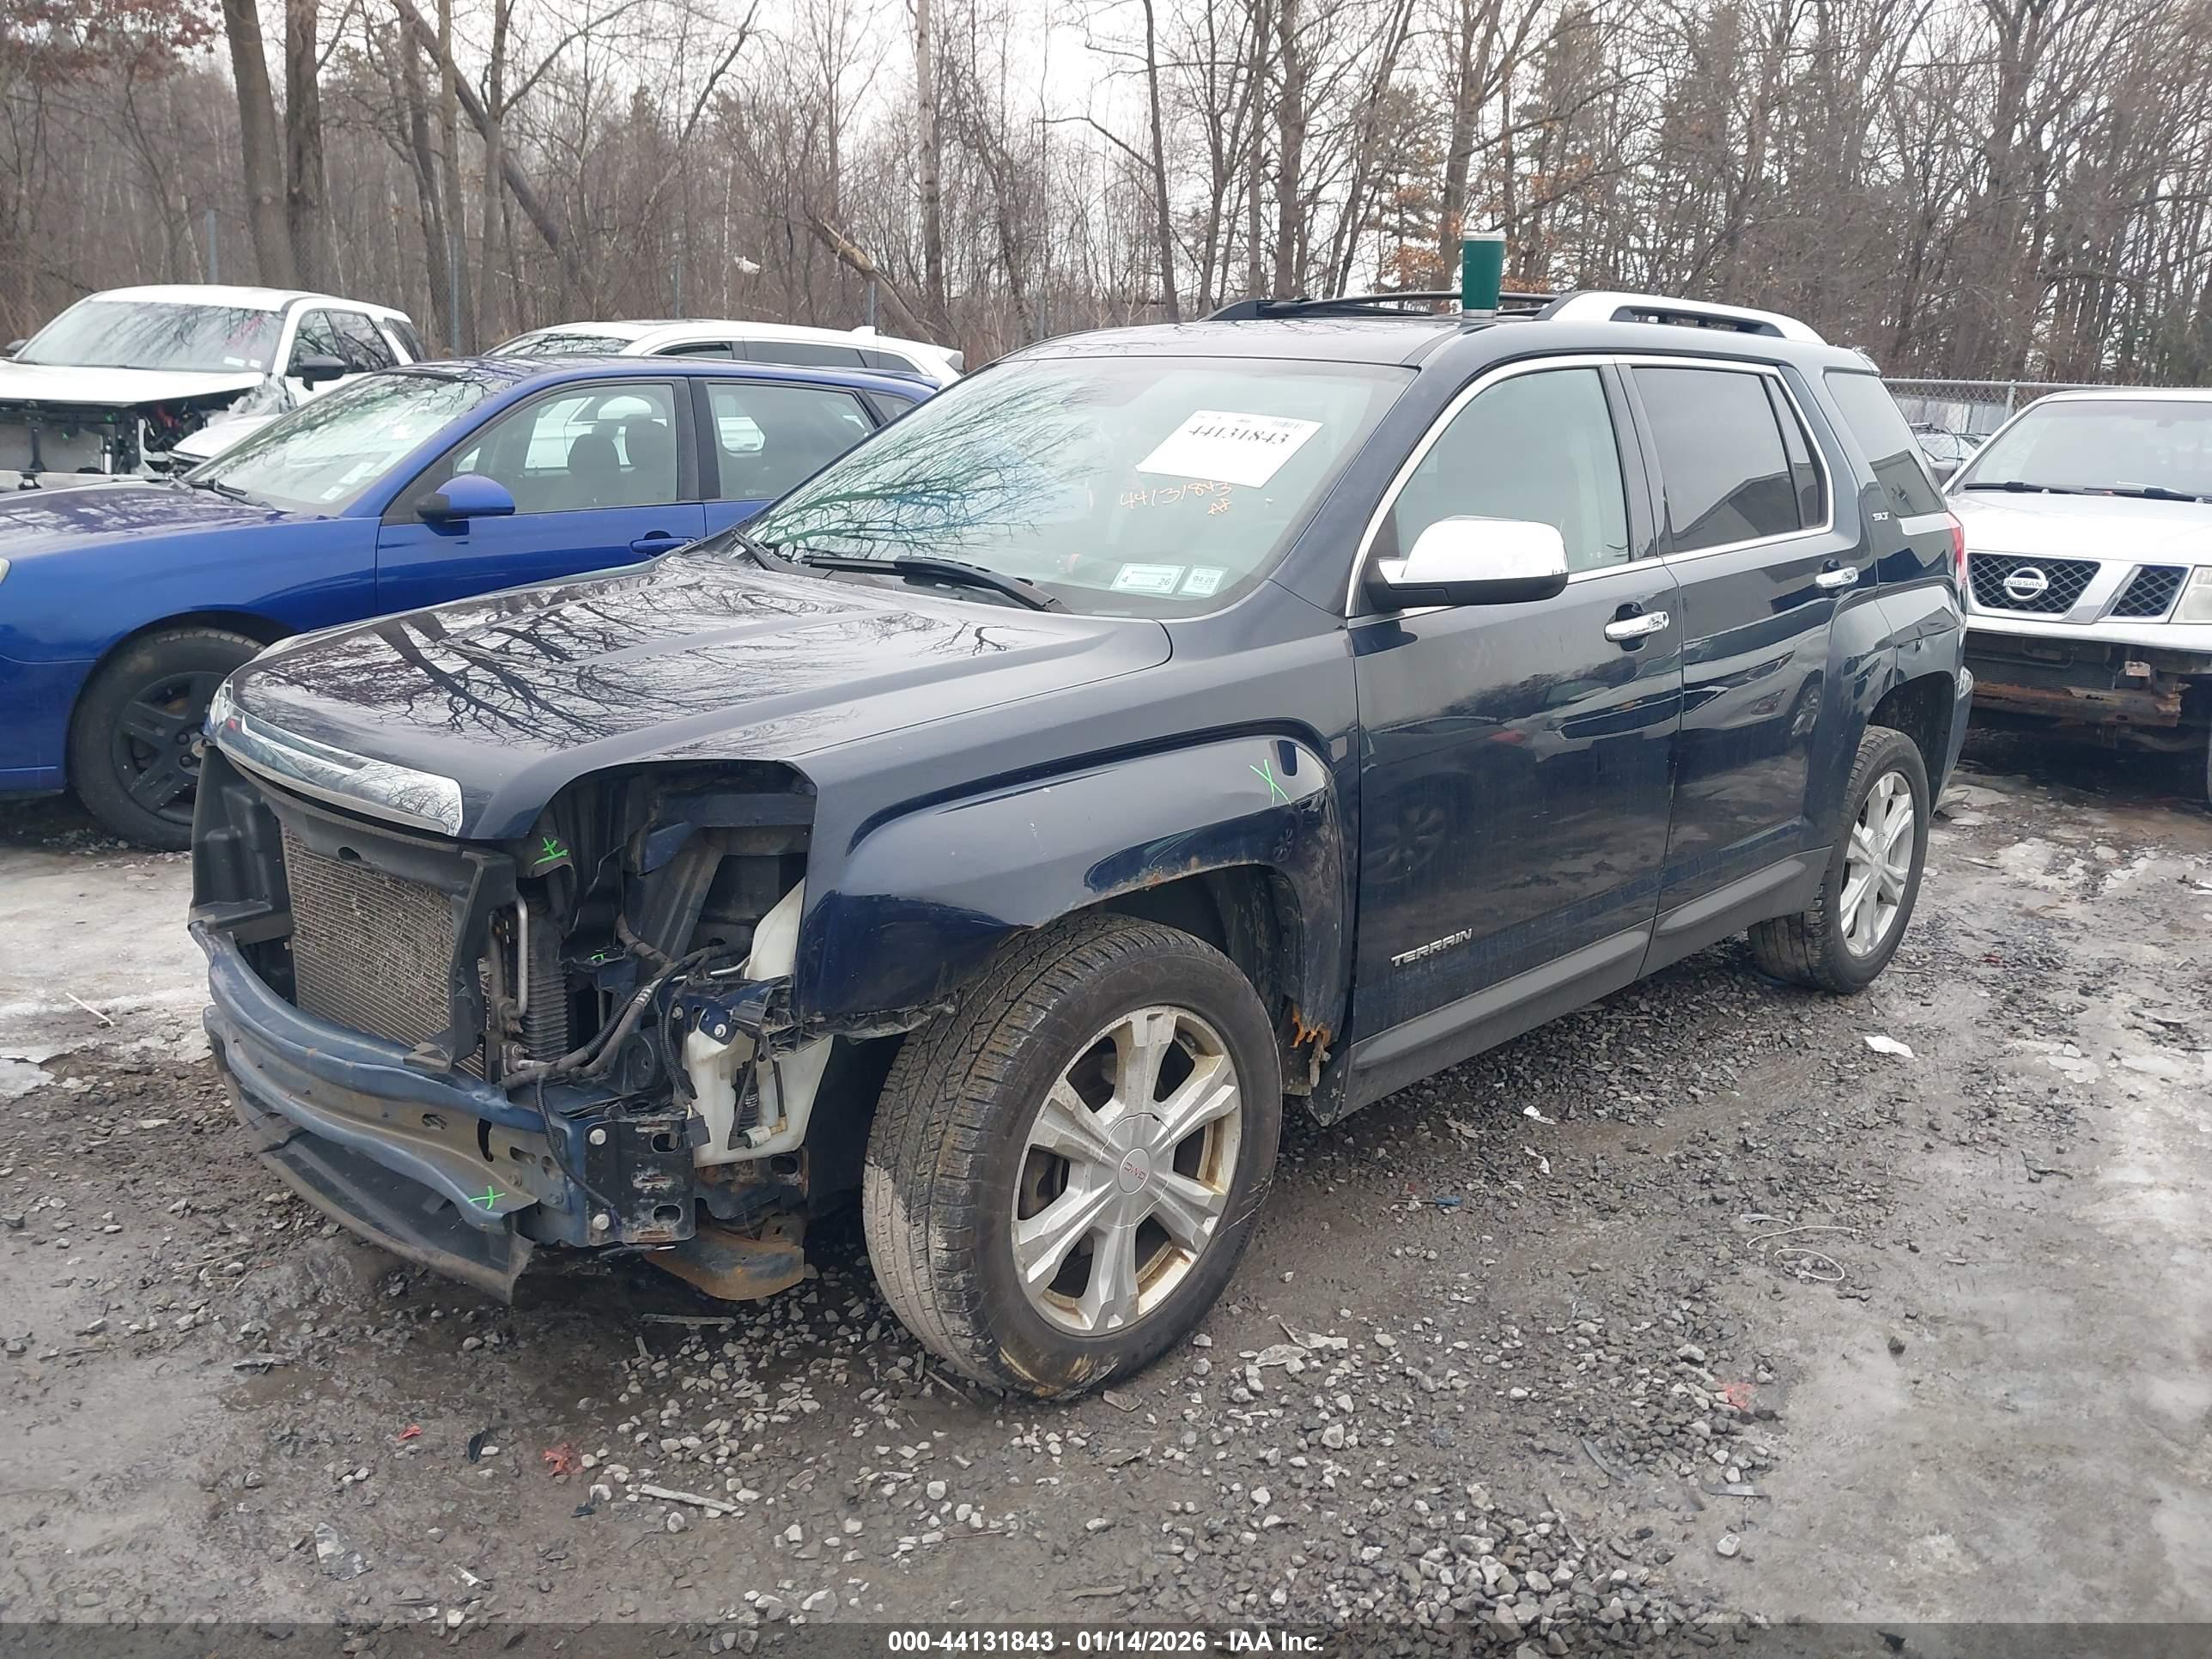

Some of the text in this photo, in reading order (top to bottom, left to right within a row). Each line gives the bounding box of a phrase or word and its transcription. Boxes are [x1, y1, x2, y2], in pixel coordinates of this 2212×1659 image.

[1188, 425, 1290, 445] 44131843
[1120, 481, 1232, 509] 44131843
[2005, 580, 2044, 588] NISSAN
[1390, 928, 1473, 967] TERRAIN
[1124, 1162, 1146, 1181] GMC
